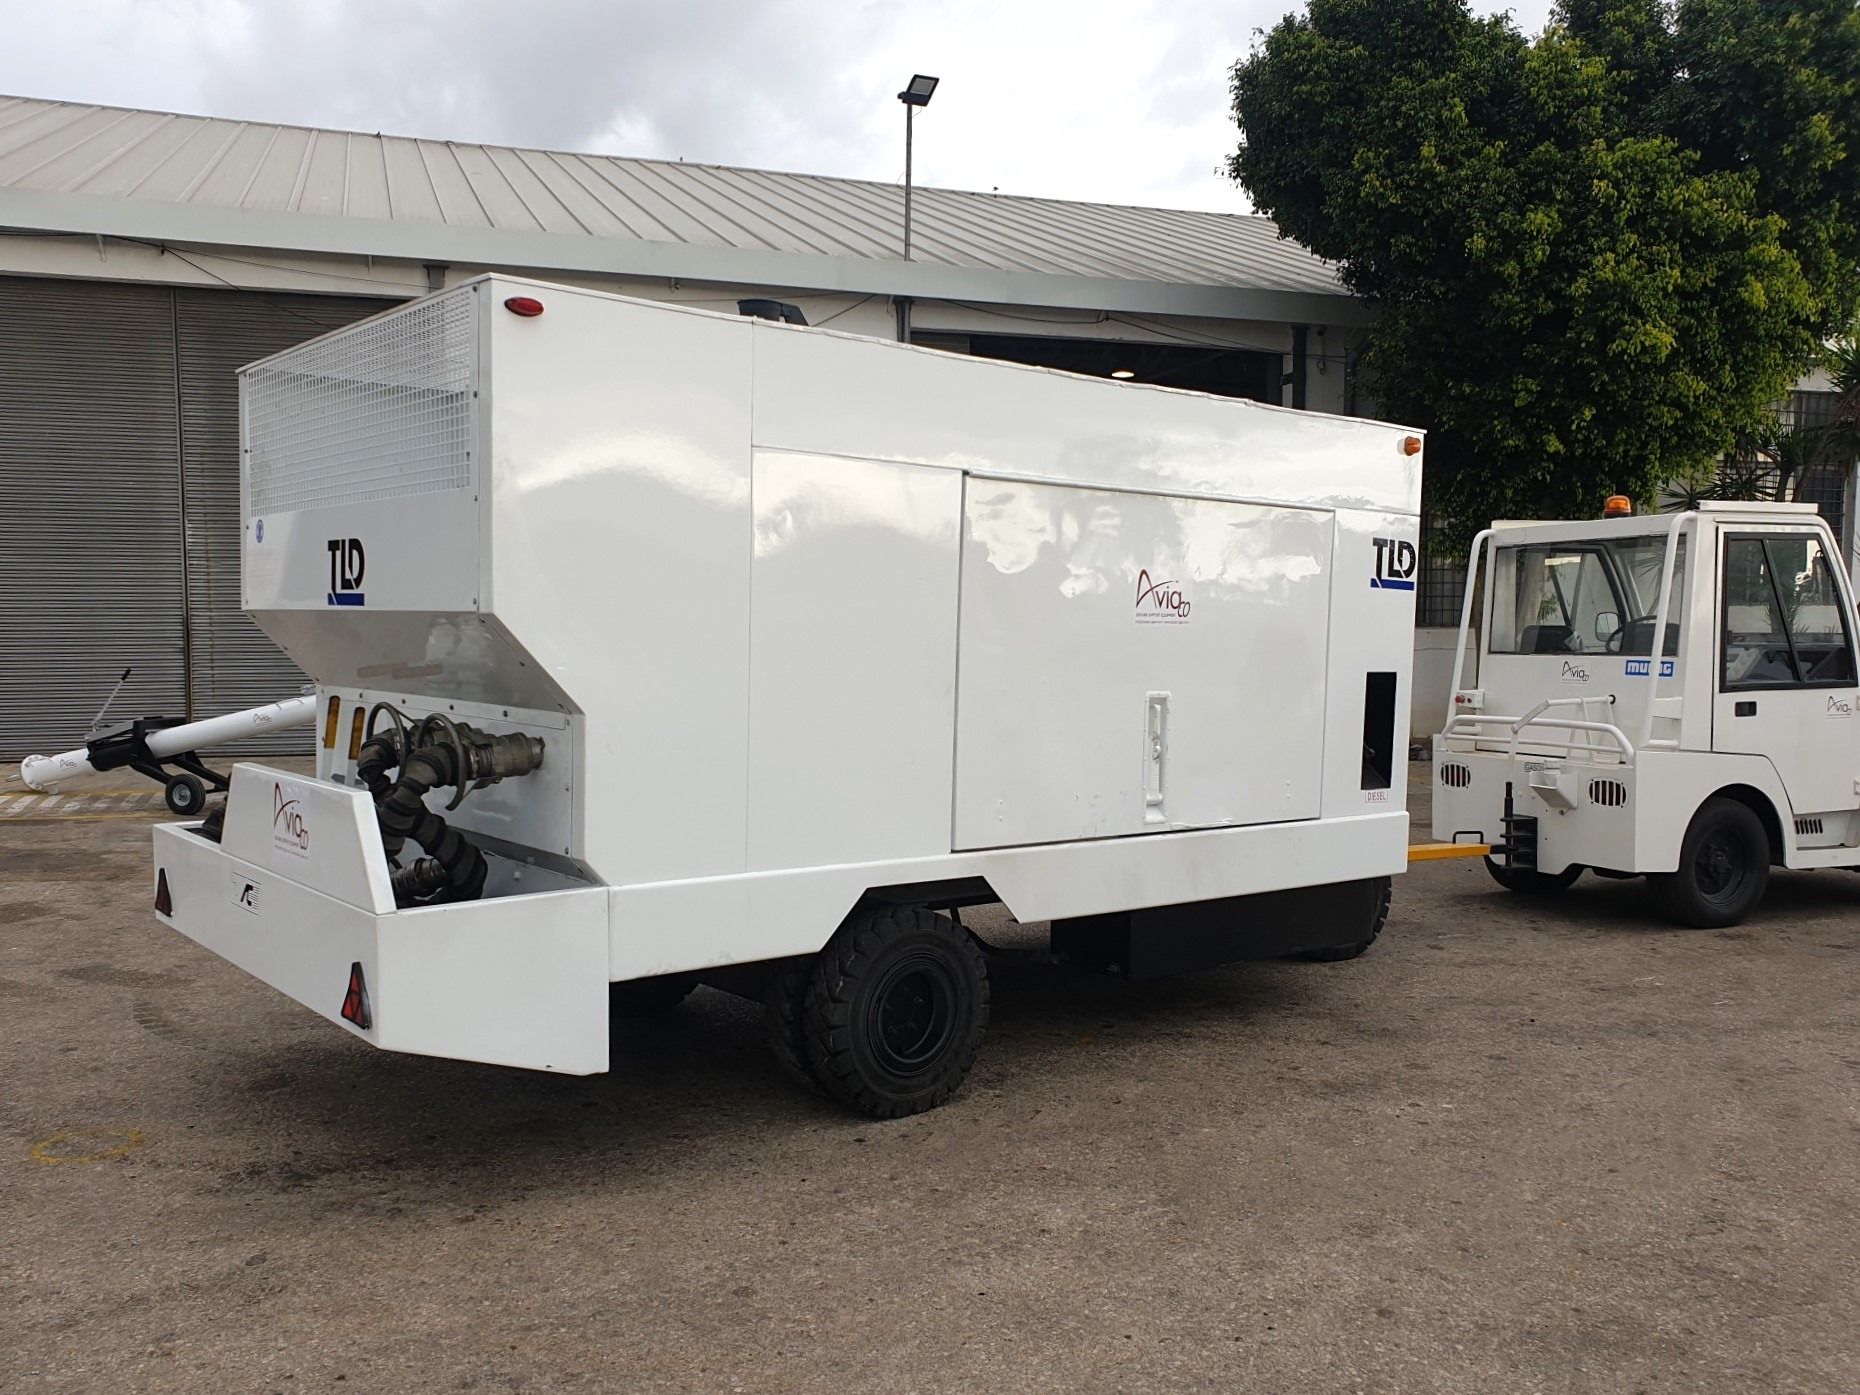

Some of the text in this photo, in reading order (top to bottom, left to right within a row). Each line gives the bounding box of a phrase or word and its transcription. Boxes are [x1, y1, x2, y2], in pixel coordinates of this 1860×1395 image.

[328, 538, 365, 598] TLD
[1372, 537, 1416, 588] TLD
[1367, 791, 1386, 801] DIESEL
